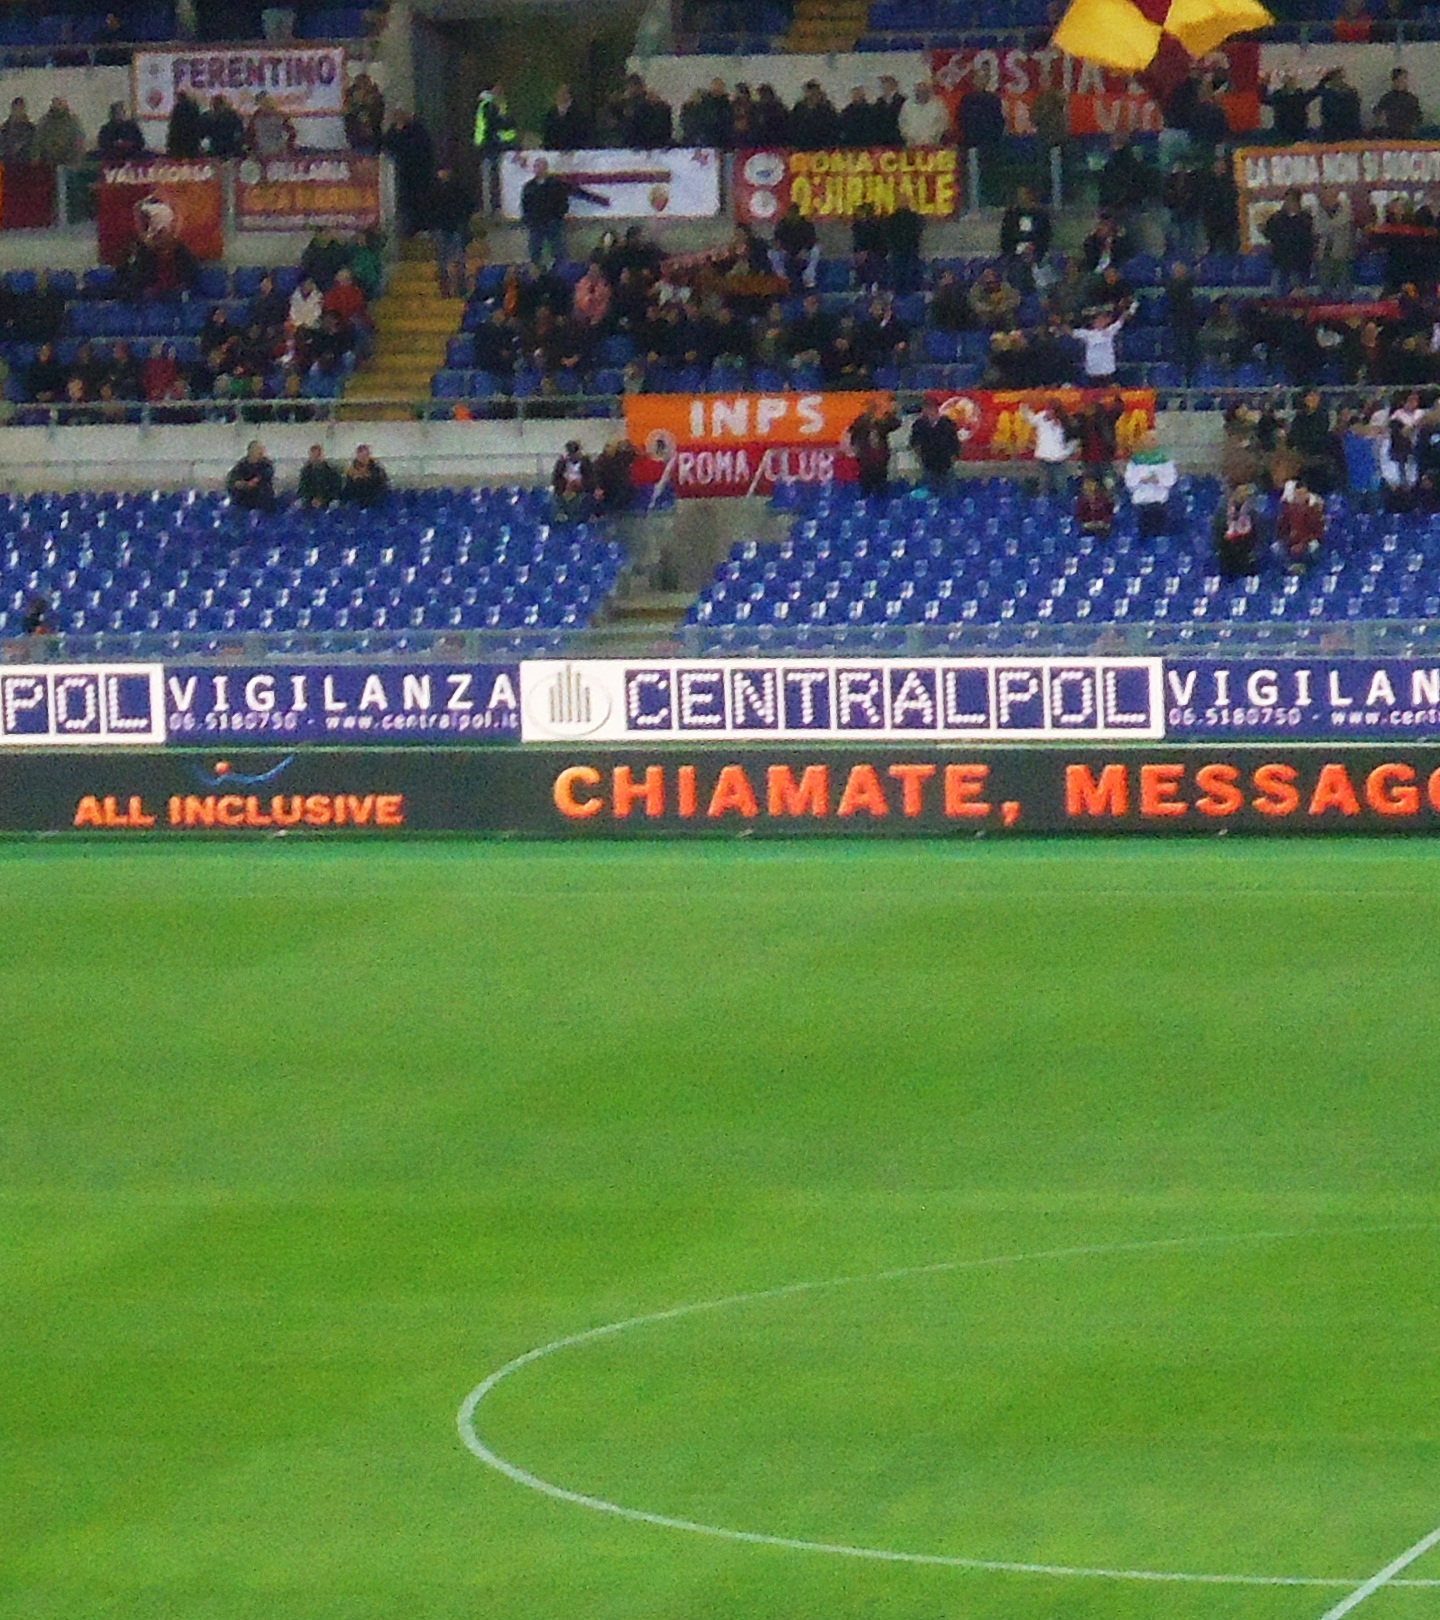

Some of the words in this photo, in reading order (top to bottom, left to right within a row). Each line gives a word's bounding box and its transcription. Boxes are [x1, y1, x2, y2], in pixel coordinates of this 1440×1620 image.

[173, 54, 338, 90] FERENTINO
[690, 396, 825, 437] INPS
[678, 449, 752, 486] ROMA
[763, 447, 835, 483] CLUB
[168, 673, 517, 711] VIGILANZA
[625, 666, 1152, 730] CENTRALPOL
[73, 795, 155, 827] ALL
[167, 794, 406, 827] INCLUSIVE
[552, 762, 1022, 826] CHIAMATE,
